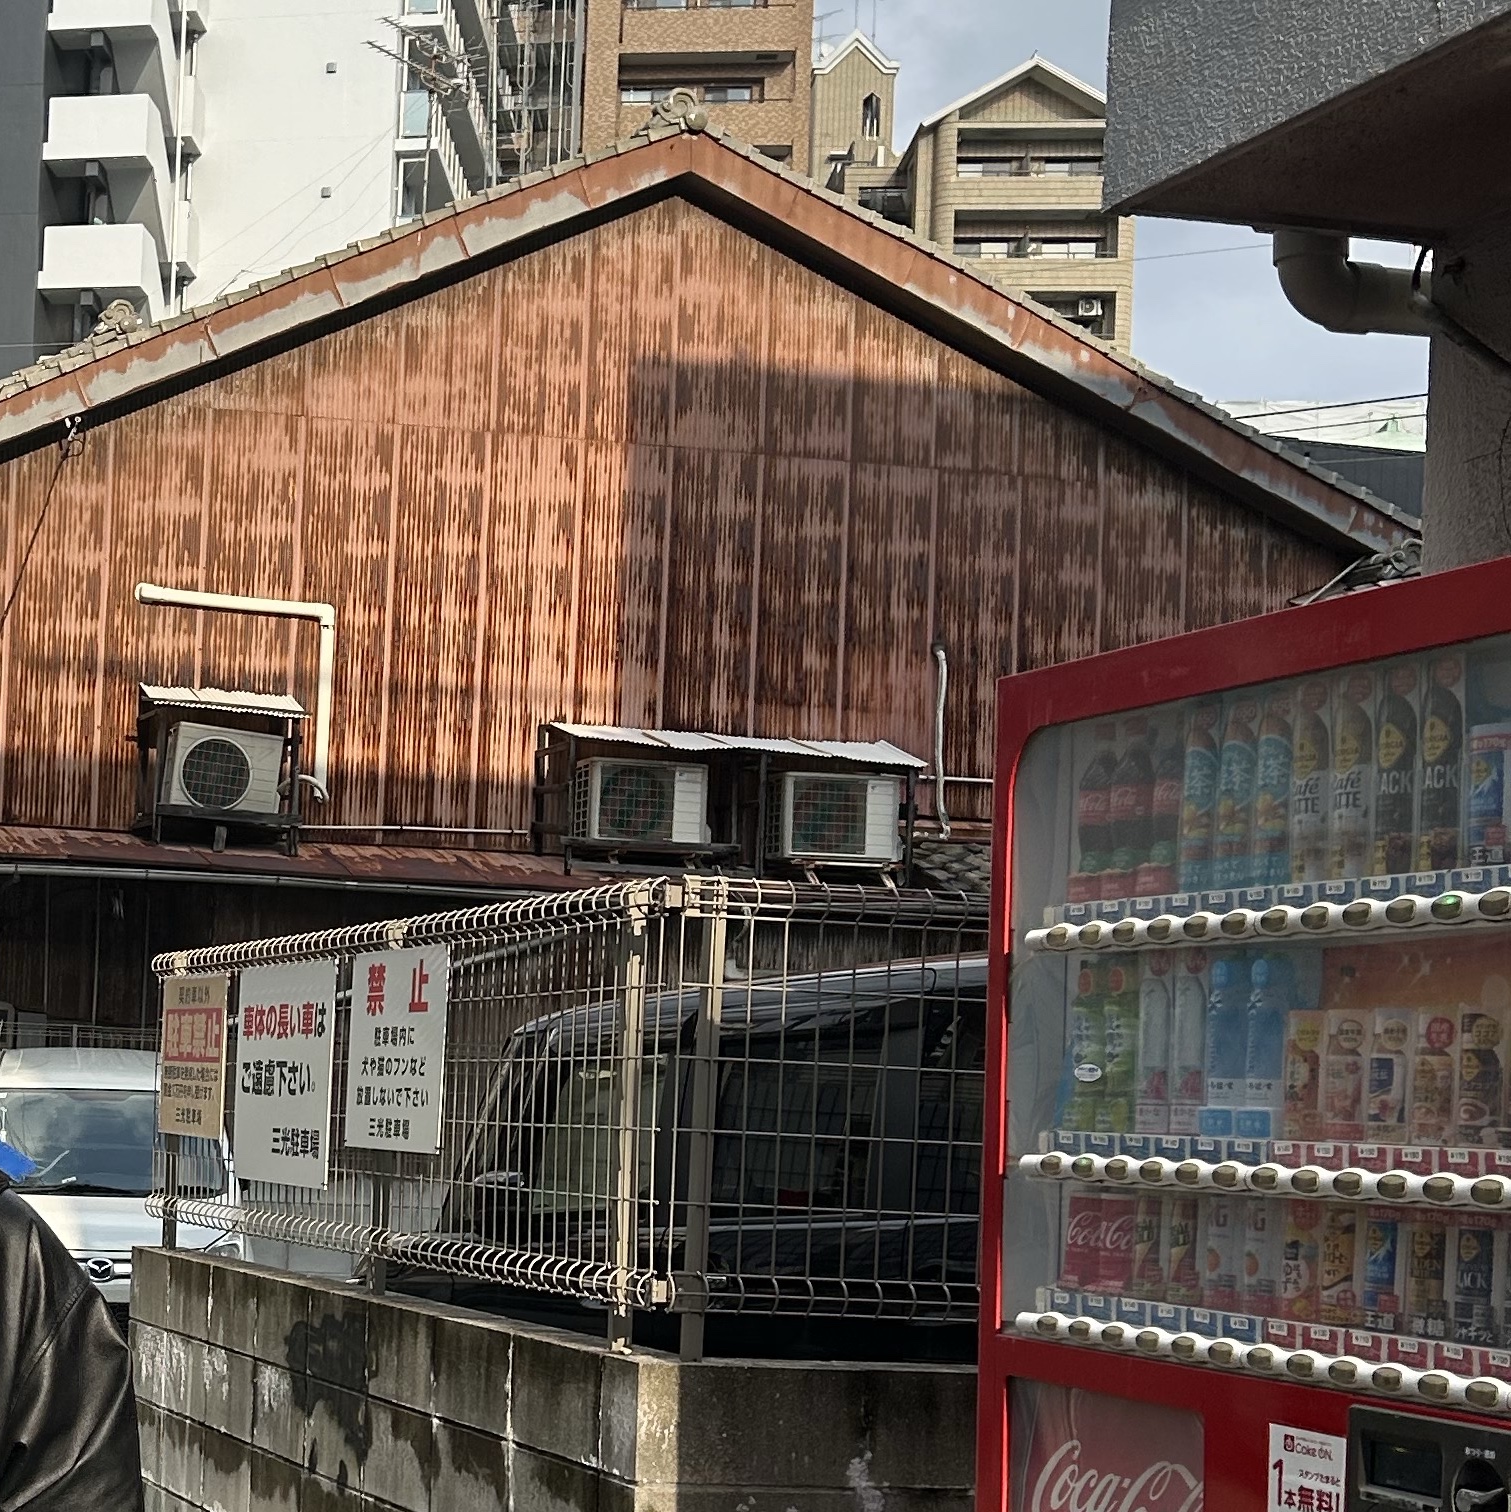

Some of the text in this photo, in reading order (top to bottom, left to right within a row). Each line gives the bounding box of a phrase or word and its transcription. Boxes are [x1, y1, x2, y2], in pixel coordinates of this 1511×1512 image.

[166, 1011, 221, 1059] 駐車禁止
[243, 1001, 327, 1041] 車体の長い車は
[373, 1025, 416, 1048] 駐車場内に
[241, 1058, 316, 1098] ご遠慮下さい。
[360, 1056, 427, 1078] 犬や猫のフンなど
[355, 1085, 429, 1108] 放置しないで下さい
[271, 1127, 320, 1160] 三光駐車場
[1295, 1442, 1317, 1458] Coke
